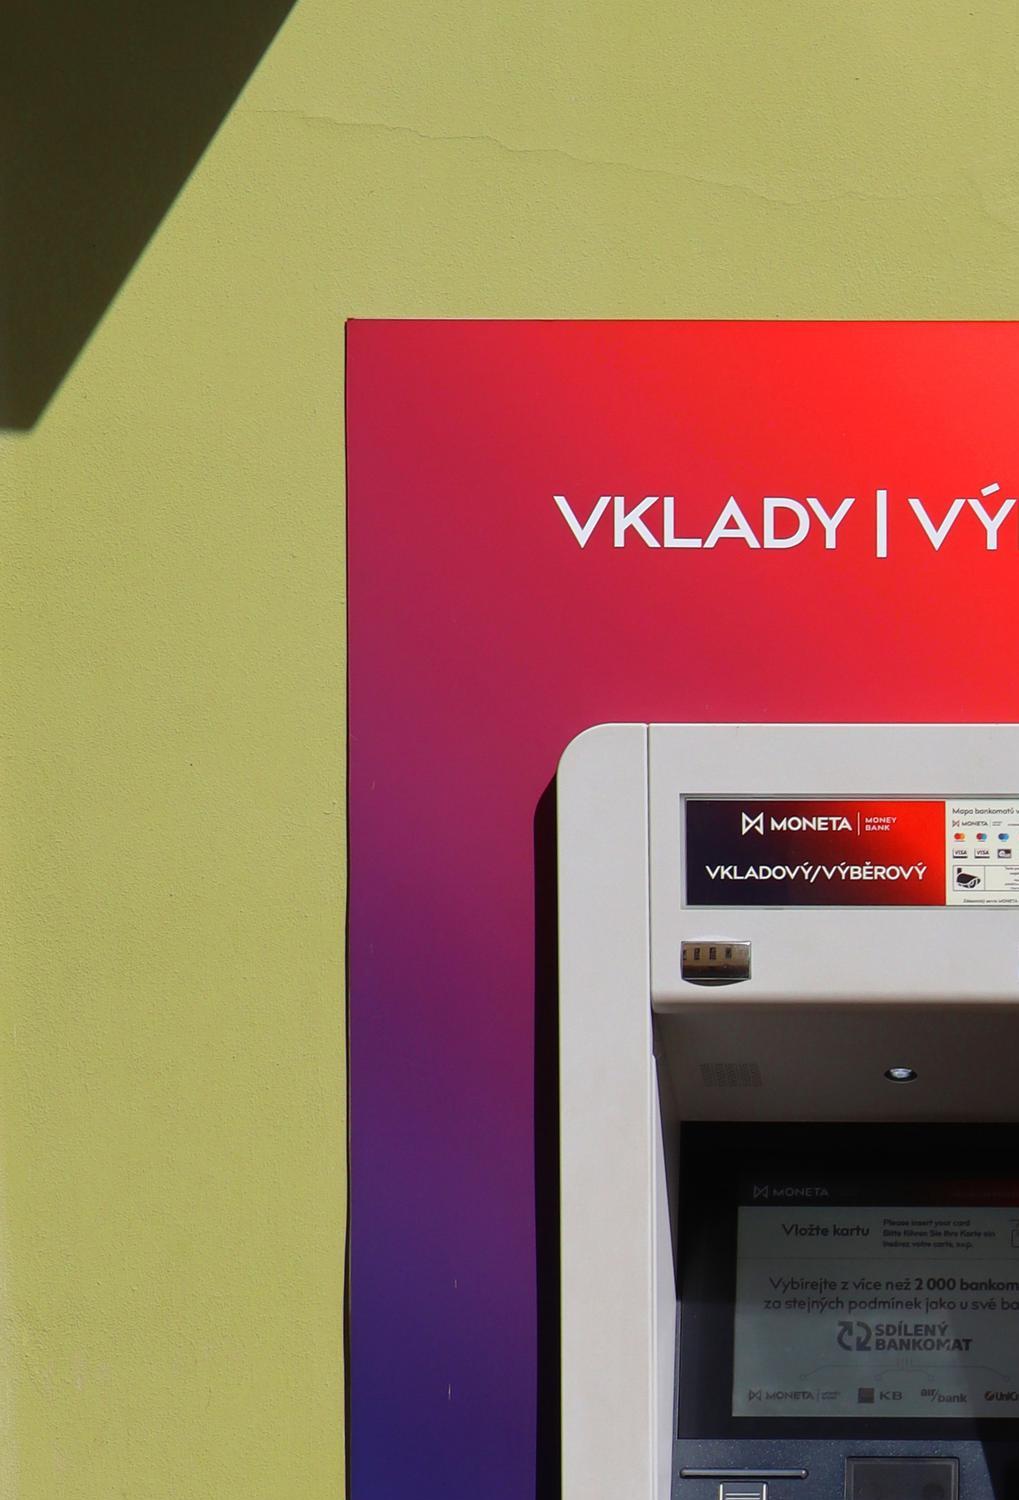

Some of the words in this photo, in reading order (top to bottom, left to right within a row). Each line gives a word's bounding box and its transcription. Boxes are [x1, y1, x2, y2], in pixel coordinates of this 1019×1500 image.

[553, 496, 856, 550] VKLADY
[952, 808, 974, 816] Mapa
[770, 816, 852, 831] MONETA
[705, 861, 927, 883] VKLADOVÝ/VÝBĚROVÝ
[772, 1187, 829, 1197] MONETA
[782, 1223, 829, 1237] Vložte
[832, 1223, 870, 1237] kartu
[769, 1277, 835, 1295] Vybírejte
[838, 1281, 848, 1290] z
[852, 1278, 882, 1291] více
[884, 1278, 911, 1291] než
[914, 1278, 923, 1291] 2
[926, 1278, 956, 1291] 000
[764, 1299, 782, 1310] za
[784, 1296, 844, 1314] stejných
[848, 1297, 922, 1314] podmínek
[924, 1297, 956, 1314] jako
[959, 1300, 968, 1311] u
[970, 1297, 997, 1311] své
[874, 1320, 949, 1337] SDÍLENÝ
[875, 1338, 973, 1351] BANKOMAT
[765, 1390, 815, 1401] MONETA
[879, 1391, 903, 1401] KB
